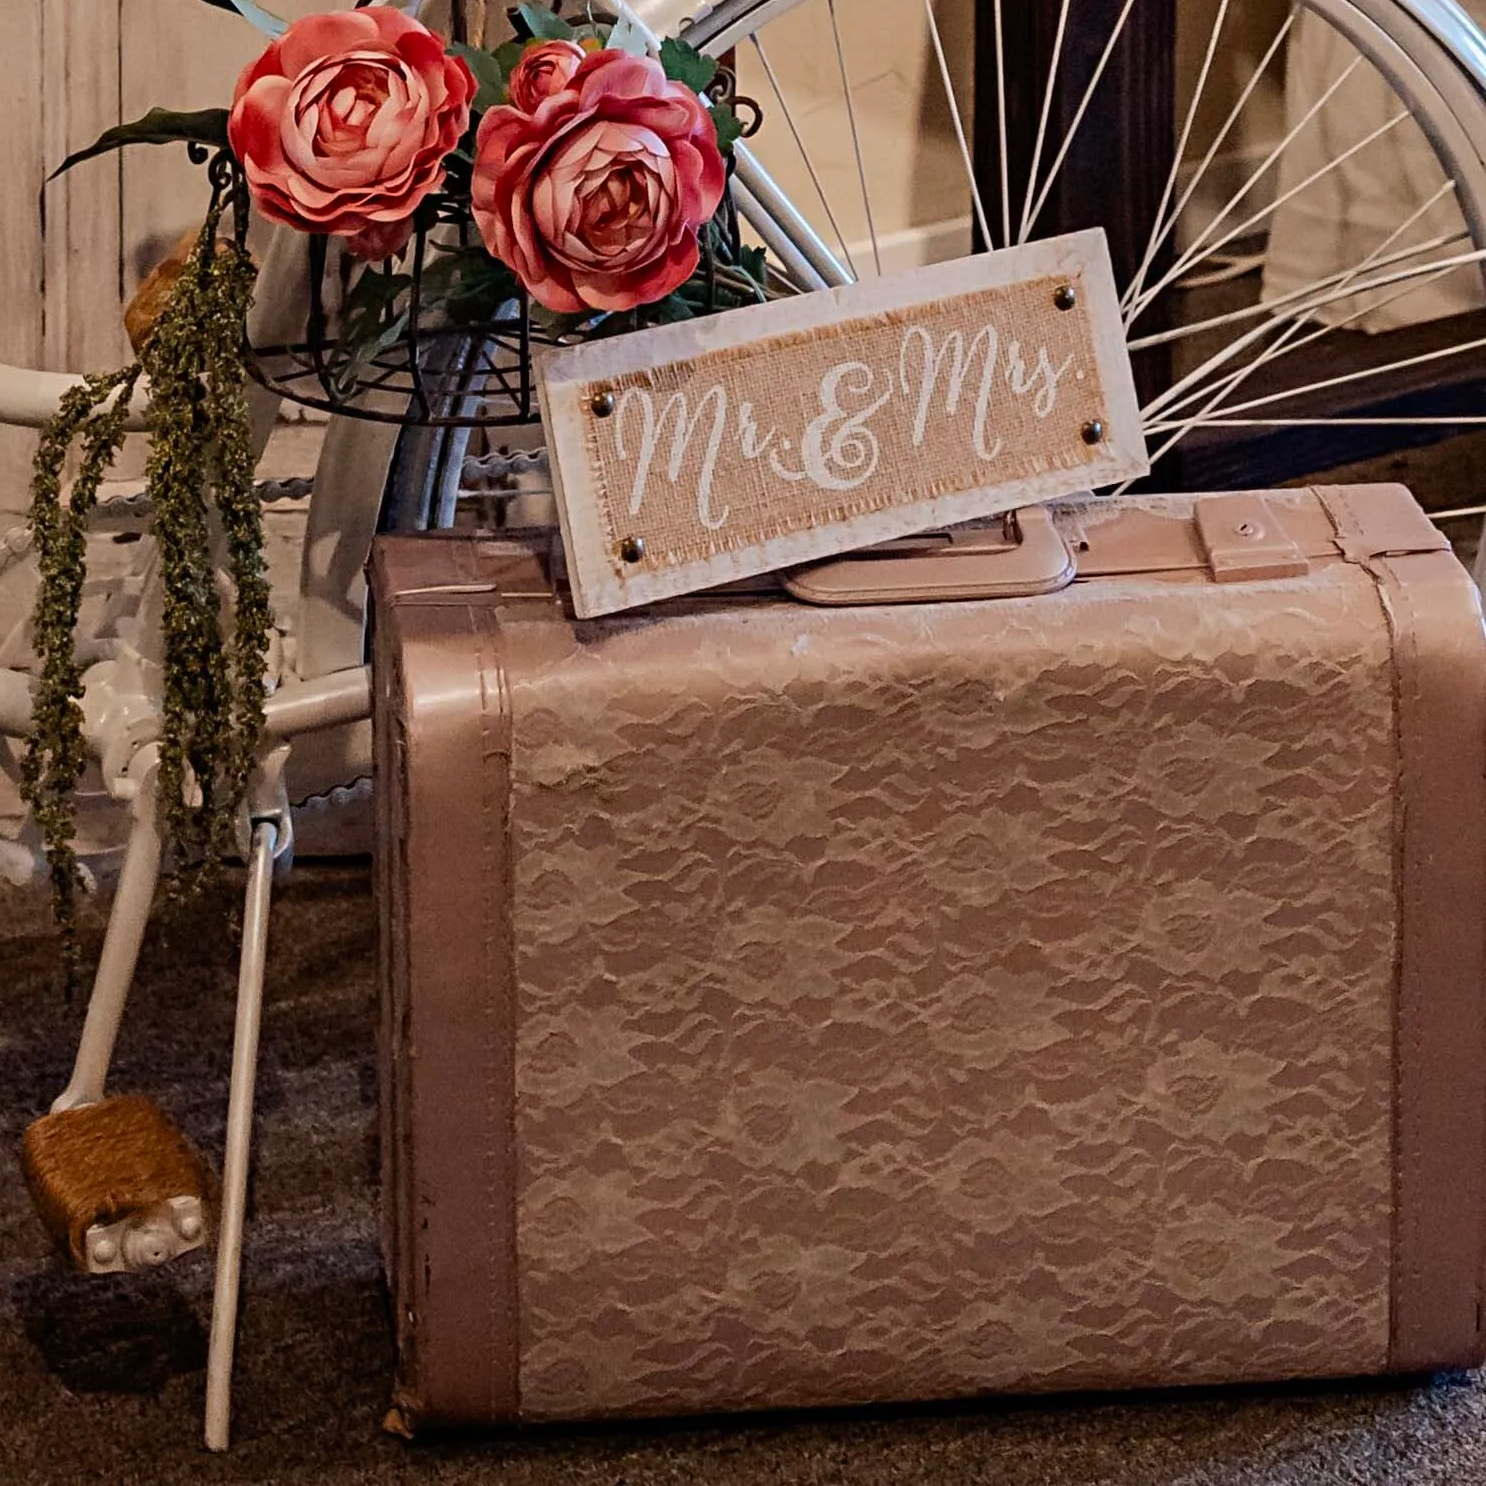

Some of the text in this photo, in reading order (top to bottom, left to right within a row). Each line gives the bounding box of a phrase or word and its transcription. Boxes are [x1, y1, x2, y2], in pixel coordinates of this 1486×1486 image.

[616, 324, 1085, 529] Mr. & Mrs.
